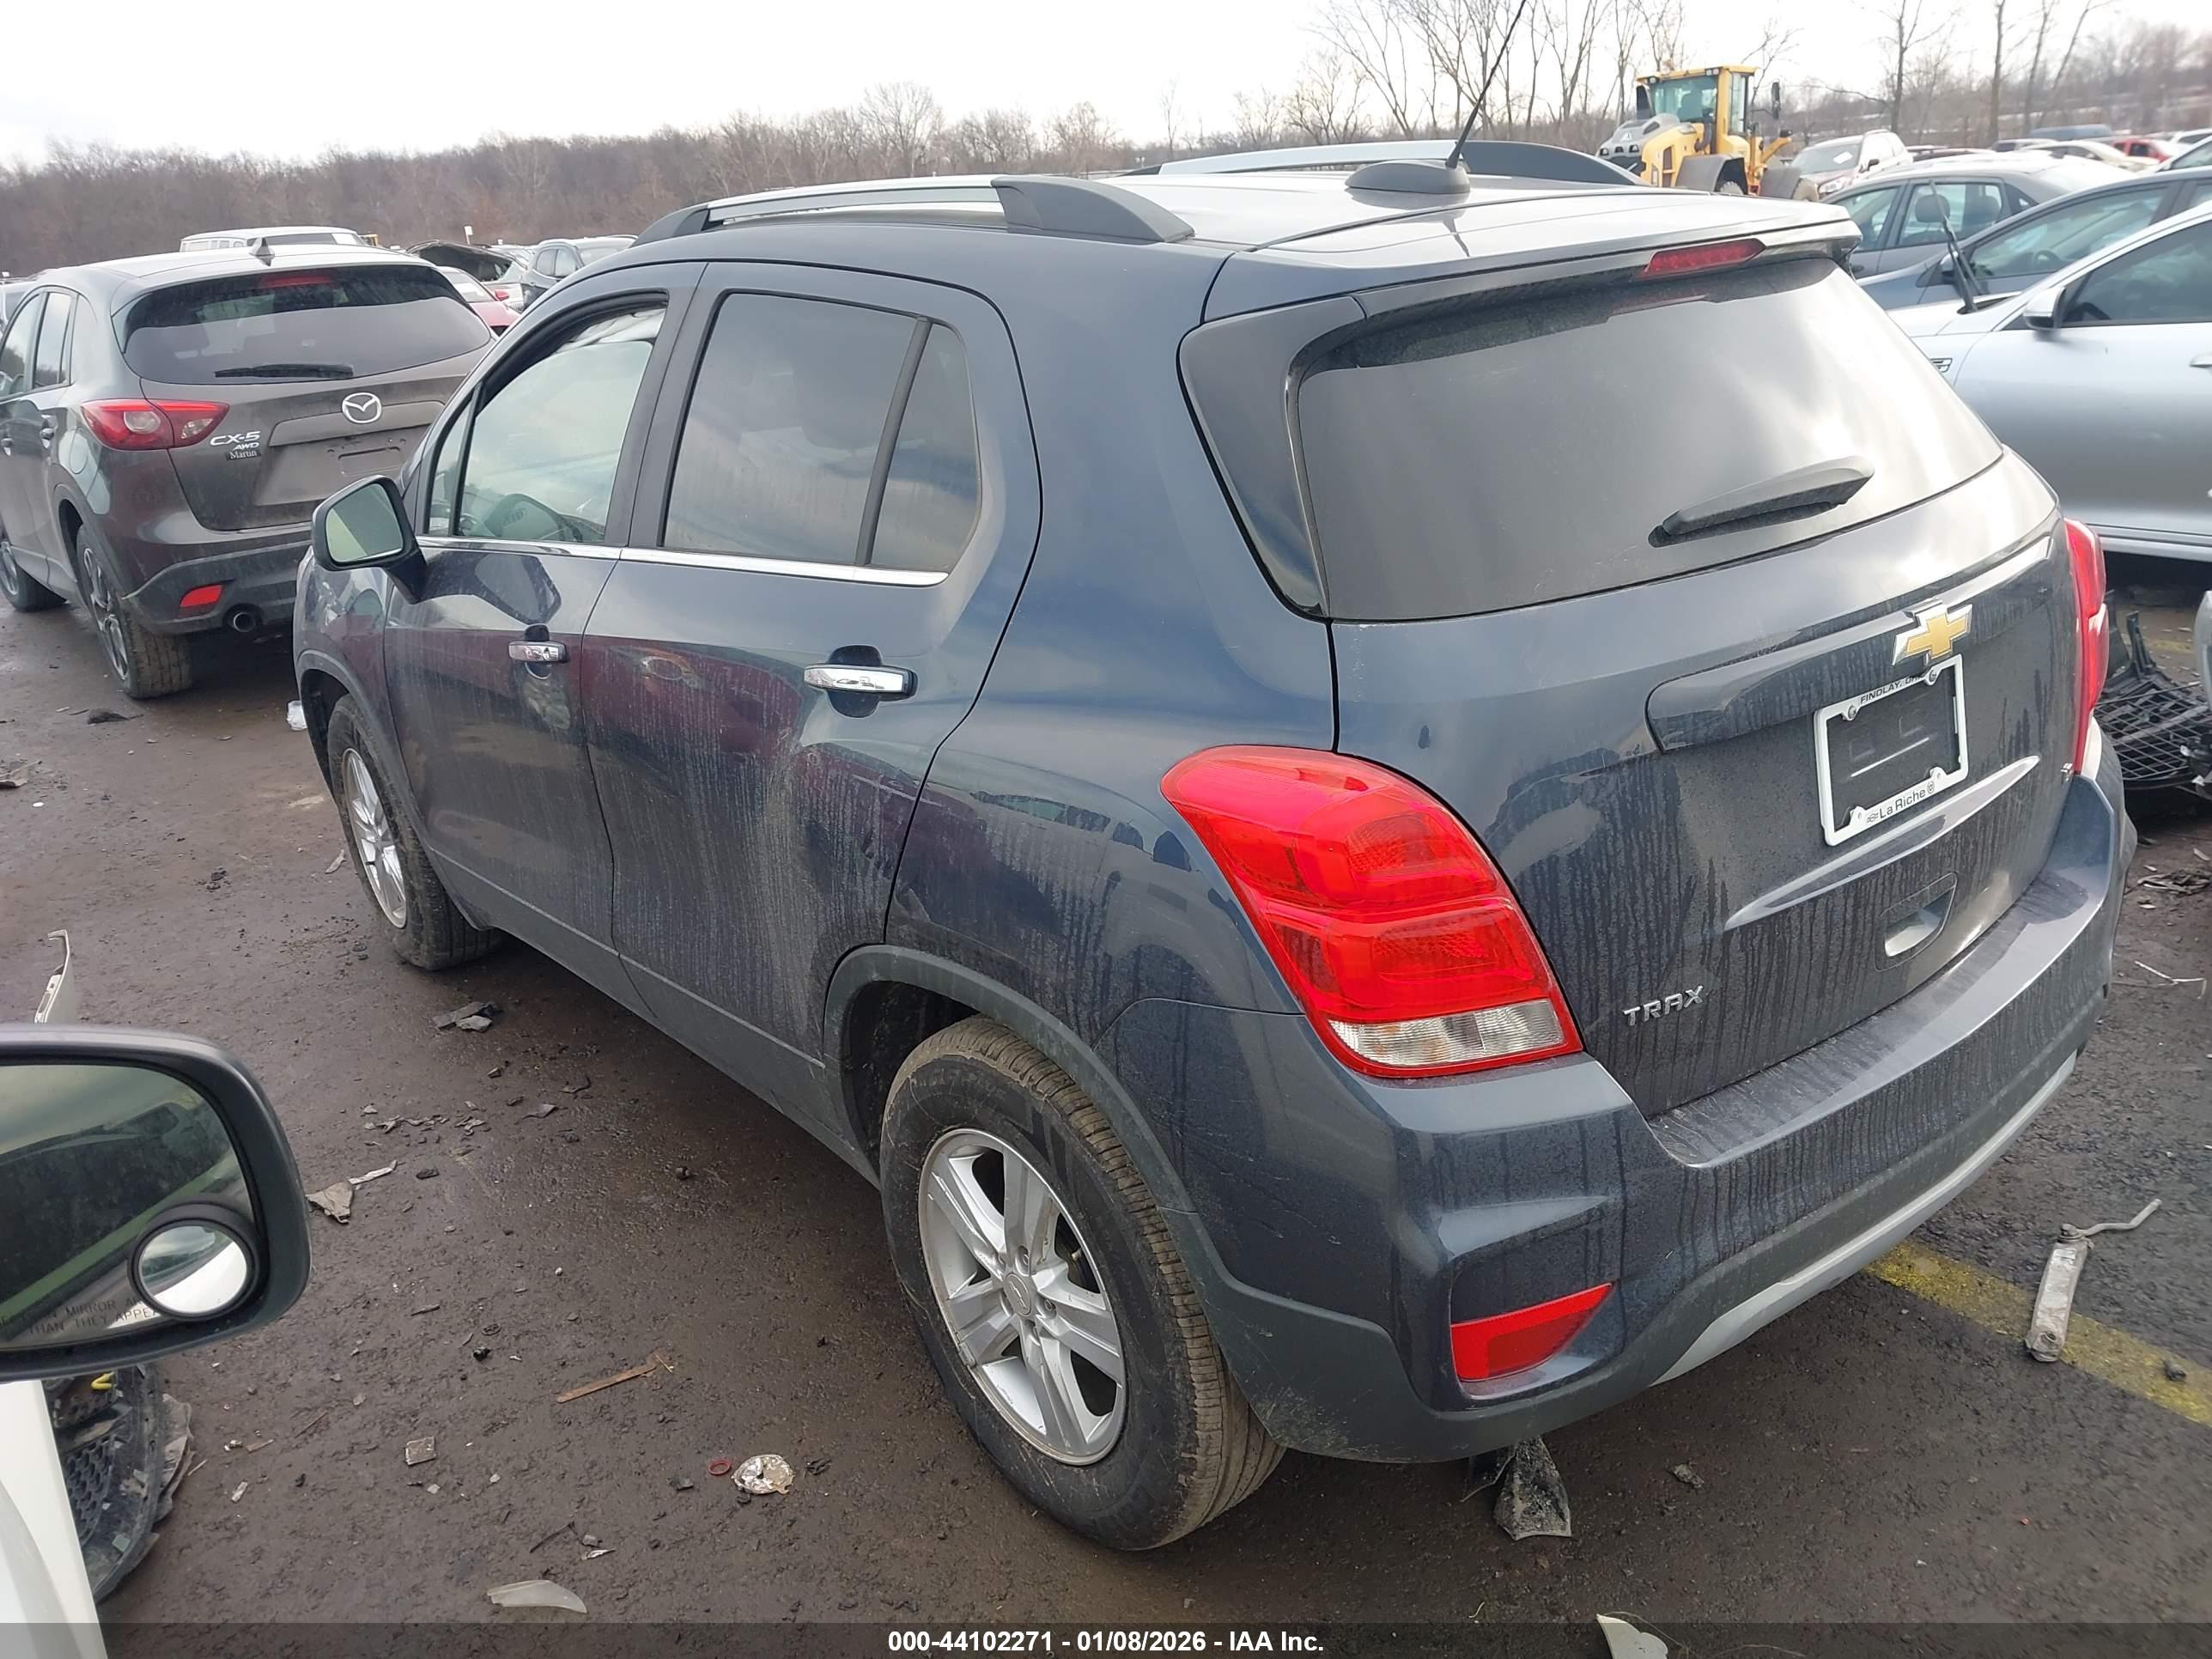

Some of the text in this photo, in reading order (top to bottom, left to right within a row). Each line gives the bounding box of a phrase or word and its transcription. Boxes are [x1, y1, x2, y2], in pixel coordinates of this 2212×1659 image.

[210, 430, 262, 447] CX-5
[233, 442, 260, 451] AWD
[228, 450, 258, 459] Martin
[1860, 680, 1903, 704] FINDLAY,
[1879, 789, 1926, 819] La Riche
[1621, 985, 1704, 1026] TRAX
[65, 1299, 116, 1316] MIRROR
[27, 1321, 64, 1335] THAN
[75, 1316, 107, 1329] THEY
